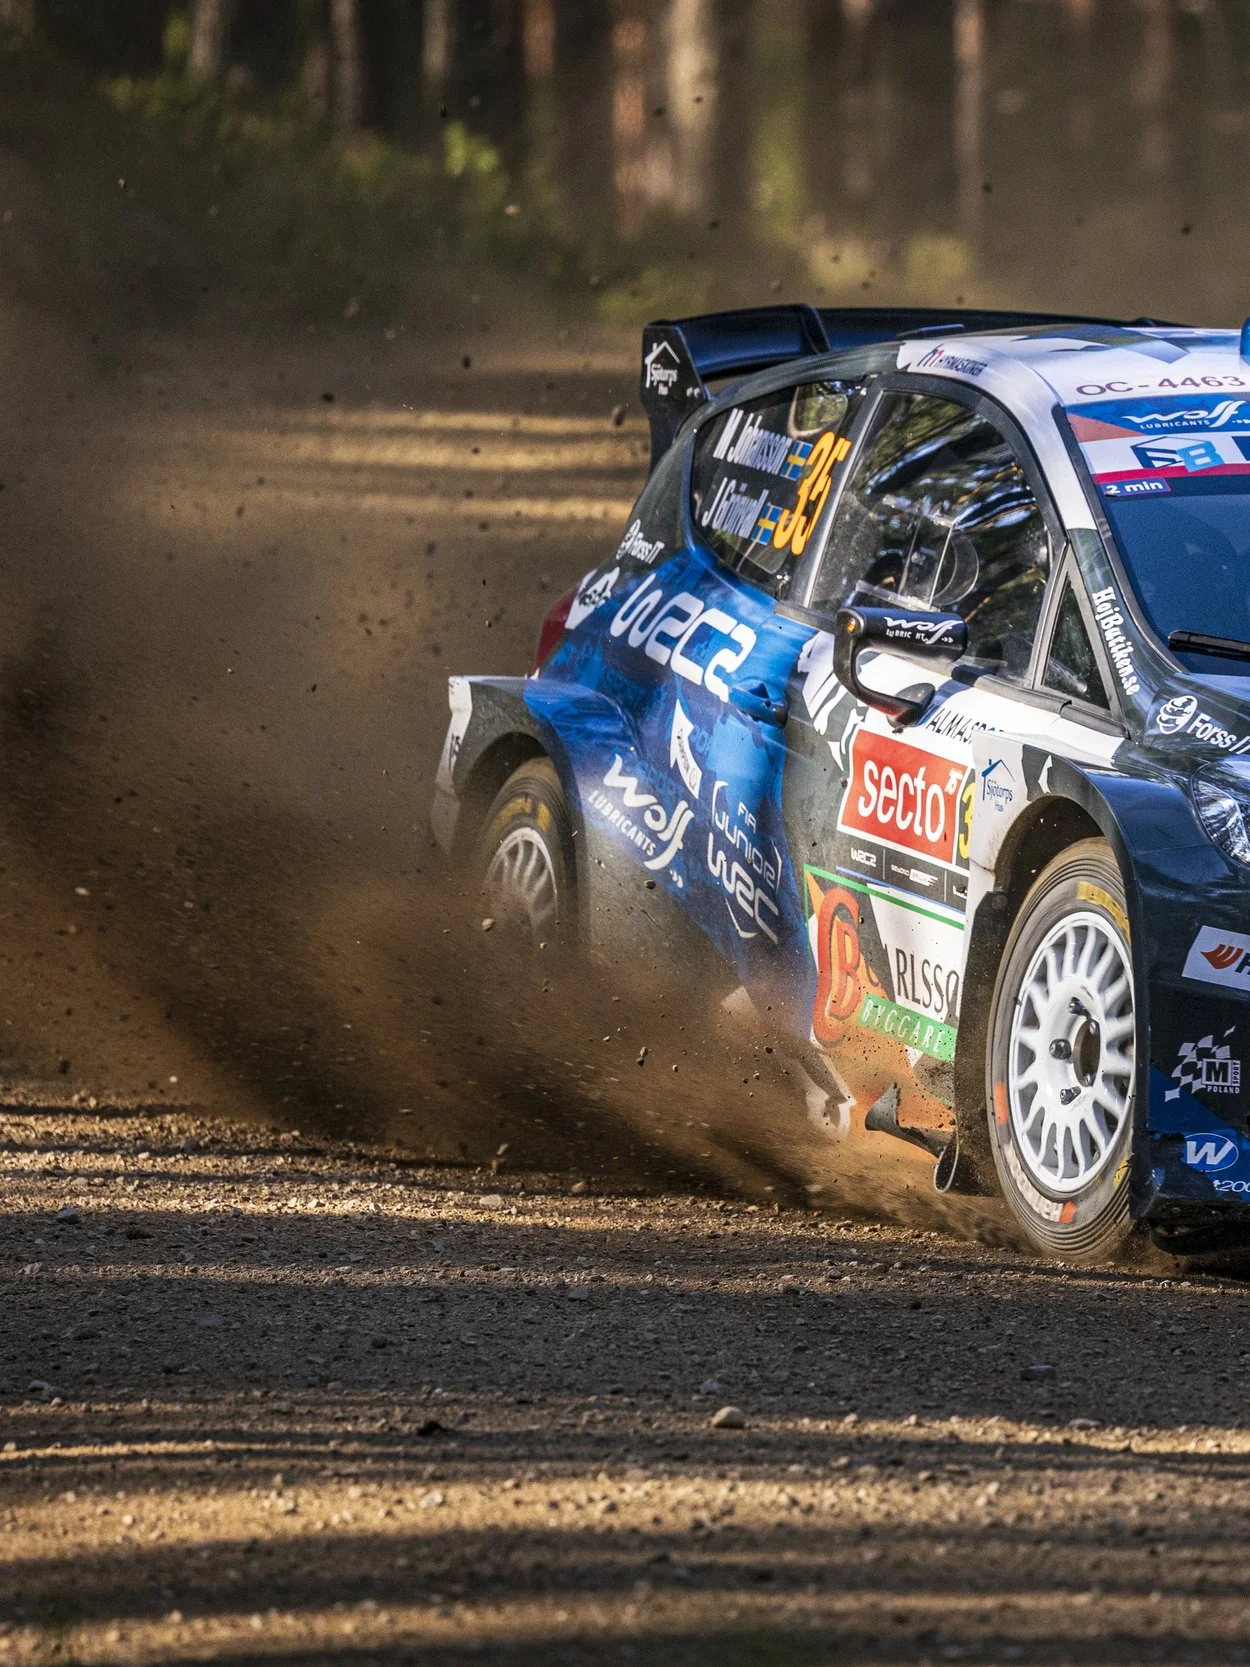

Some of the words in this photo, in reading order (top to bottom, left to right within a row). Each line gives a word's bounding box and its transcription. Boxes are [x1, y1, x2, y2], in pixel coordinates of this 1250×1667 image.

[1076, 375, 1247, 397] OC-4463
[1139, 419, 1211, 430] LUBRICANTS
[773, 431, 852, 556] 35
[1105, 482, 1121, 495] 2
[1124, 480, 1164, 493] min
[610, 573, 757, 703] WRC2
[886, 628, 929, 643] LUBRICNTS
[1186, 711, 1237, 748] Forss
[737, 801, 757, 834] FIA
[857, 759, 945, 842] secto
[588, 790, 657, 857] LUBRICANTS
[714, 811, 776, 890] JUNIOR
[707, 832, 779, 945] WRC
[861, 999, 946, 1053] BYGGARE
[1206, 1060, 1229, 1083] M
[1231, 1061, 1240, 1085] SPORT
[1206, 1085, 1241, 1094] POLAND
[1186, 1141, 1235, 1165] W
